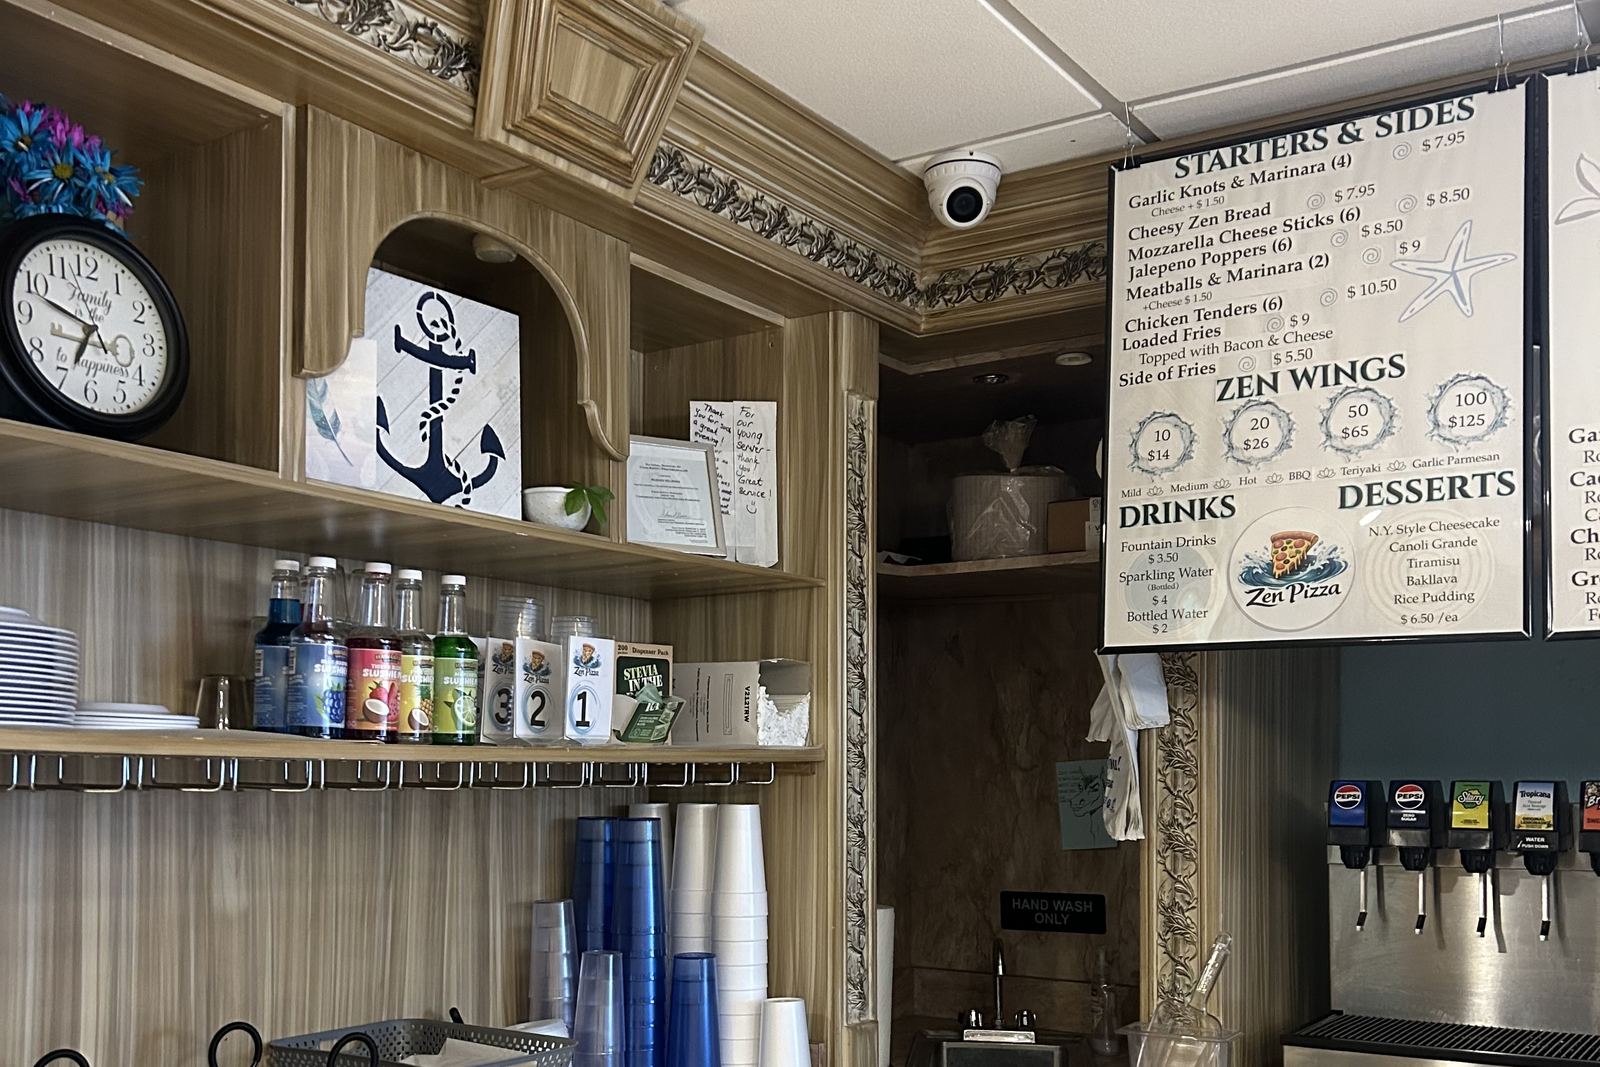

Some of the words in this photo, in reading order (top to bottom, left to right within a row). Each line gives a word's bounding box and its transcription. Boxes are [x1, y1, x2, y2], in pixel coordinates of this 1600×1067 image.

[1175, 127, 1329, 179] STARTERS
[1338, 121, 1364, 145] &
[1376, 96, 1475, 138] SIDES
[1129, 189, 1175, 209] Garlic
[1180, 180, 1226, 200] Knots
[1231, 176, 1244, 189] &
[1250, 160, 1325, 186] Marinara
[1331, 153, 1352, 172] (4)
[1129, 221, 1184, 241] Cheesy
[1188, 215, 1219, 230] Zen
[1224, 202, 1271, 223] Bread
[1152, 204, 1185, 218] Cheese
[1128, 236, 1214, 262] Mozzarella
[1220, 223, 1277, 244] Cheese
[1282, 213, 1334, 234] Sticks
[1340, 206, 1361, 224] (6)
[48, 253, 67, 280] 11
[76, 253, 98, 282] 12
[1128, 258, 1196, 283] Jalepeno
[1201, 245, 1267, 266] Poppers
[1272, 236, 1292, 252] (6)
[26, 270, 48, 297] 10
[114, 273, 122, 296] 1
[1126, 276, 1203, 301] Meatballs
[1208, 272, 1222, 286] &
[1226, 260, 1303, 283] Marinara
[1308, 253, 1330, 270] (2)
[67, 282, 112, 316] Family
[18, 300, 33, 325] 9
[132, 300, 146, 325] 2
[1125, 314, 1188, 333] Chicken
[1194, 302, 1258, 322] Tenders
[1262, 296, 1283, 312] (6)
[30, 336, 44, 363] 8
[142, 332, 156, 358] 3
[1122, 330, 1178, 351] Loaded
[1183, 326, 1222, 342] Fries
[1139, 348, 1186, 366] Topped
[1190, 342, 1220, 356] with
[1224, 338, 1264, 353] Bacon
[1268, 335, 1280, 347] &
[1284, 329, 1334, 344] Cheese
[56, 346, 68, 363] to
[56, 366, 69, 390] 7
[132, 364, 146, 387] 4
[1119, 372, 1152, 388] Side
[1157, 365, 1174, 381] of
[1178, 362, 1216, 378] Fries
[1216, 370, 1280, 402] ZEN
[1288, 353, 1406, 391] WINGS
[84, 380, 98, 404] 6
[112, 380, 127, 404] 5
[1456, 392, 1487, 408] 100
[1348, 404, 1368, 418] 50
[1448, 414, 1486, 430] $125
[1250, 416, 1270, 431] 20
[1342, 424, 1369, 440] $65
[1154, 429, 1170, 442] 10
[1244, 437, 1270, 451] $26
[1148, 450, 1170, 462] $14
[1121, 488, 1142, 498] Mild
[1170, 482, 1208, 493] Medium
[1239, 476, 1257, 486] Hot
[1288, 470, 1312, 481] BBQ
[1340, 464, 1382, 476] Teriyaki
[1412, 454, 1444, 469] Garlic
[1447, 452, 1500, 466] Parmesan
[1338, 470, 1516, 510] DESSERTS
[1119, 494, 1236, 528] DRINKS
[1368, 526, 1394, 536] N.Y.
[1396, 522, 1426, 538] Style
[1428, 517, 1500, 533] Cheesecake
[1121, 538, 1172, 552] Fountain
[1176, 534, 1217, 548] Drinks
[1390, 540, 1429, 552] Canoli
[1432, 536, 1478, 550] Grande
[1406, 556, 1460, 569] Tiramisu
[1119, 569, 1176, 586] Sparkling
[1178, 566, 1214, 578] Water
[1147, 582, 1180, 592] (Bottled)
[1406, 574, 1458, 586] Bakllava
[1244, 588, 1285, 608] Zen
[1286, 582, 1342, 604] Pizza
[1394, 594, 1418, 605] Rice
[1422, 590, 1476, 604] Pudding
[1127, 609, 1168, 622] Bottled
[1172, 608, 1208, 620] Water
[1438, 612, 1458, 624] /ea
[632, 647, 656, 655] Dispenser
[574, 666, 584, 676] Zen
[624, 664, 658, 680] STEVIA
[628, 678, 640, 692] IN
[494, 688, 512, 724] 3
[530, 690, 546, 727] 2
[576, 691, 590, 728] 1
[1458, 791, 1484, 806] Starry
[1520, 790, 1551, 799] Tropicana
[1012, 898, 1049, 912] HAND
[1052, 900, 1093, 912] WASH
[1034, 912, 1070, 925] ONLY
